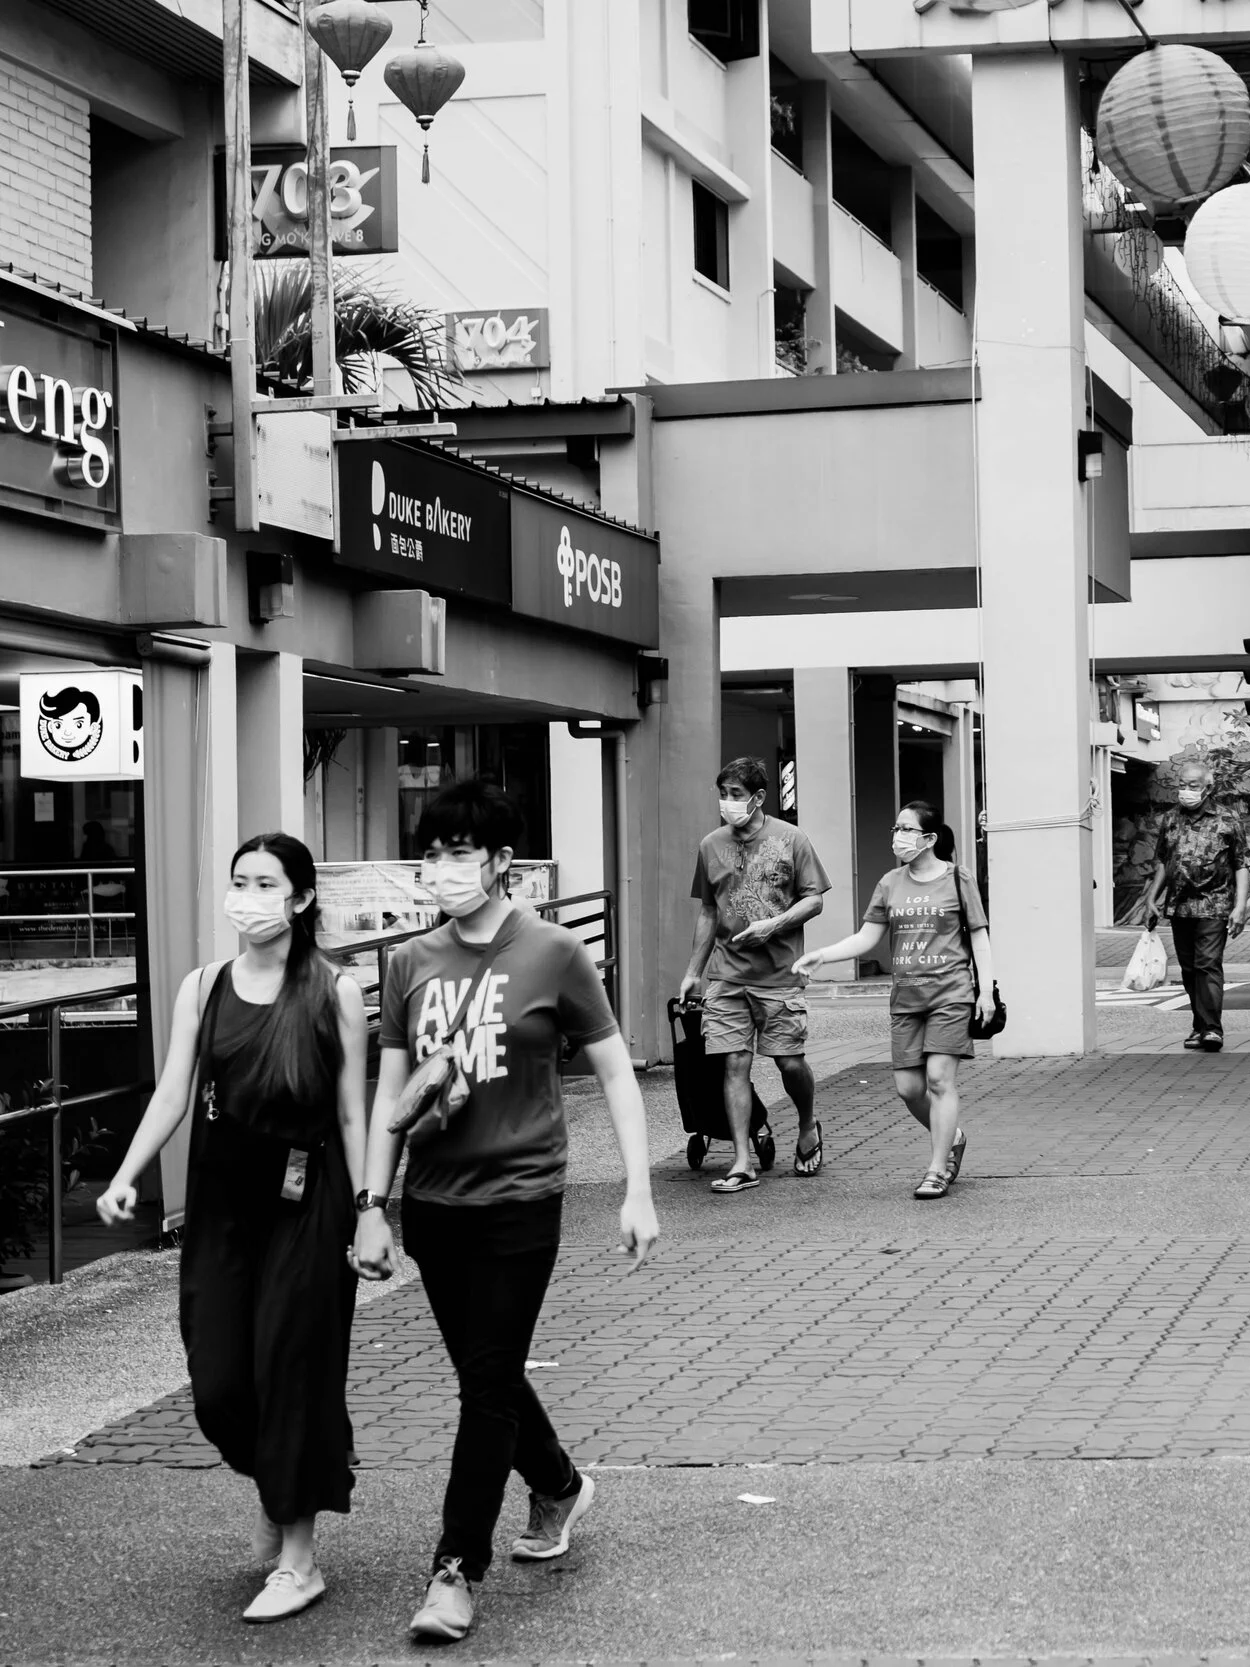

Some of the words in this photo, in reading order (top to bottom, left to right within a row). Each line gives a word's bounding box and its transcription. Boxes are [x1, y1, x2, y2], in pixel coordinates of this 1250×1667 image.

[250, 160, 362, 222] 703
[356, 229, 364, 243] 8
[461, 315, 531, 351] 704
[0, 320, 112, 488] eng
[389, 491, 422, 528] DUKE
[426, 496, 471, 542] BAKERY
[575, 548, 622, 608] POSB
[890, 906, 945, 917] ANGELES
[906, 895, 930, 904] LOS
[893, 956, 912, 966] ORK
[918, 955, 948, 964] CITY
[902, 941, 928, 951] NEW
[416, 1023, 508, 1083] ME
